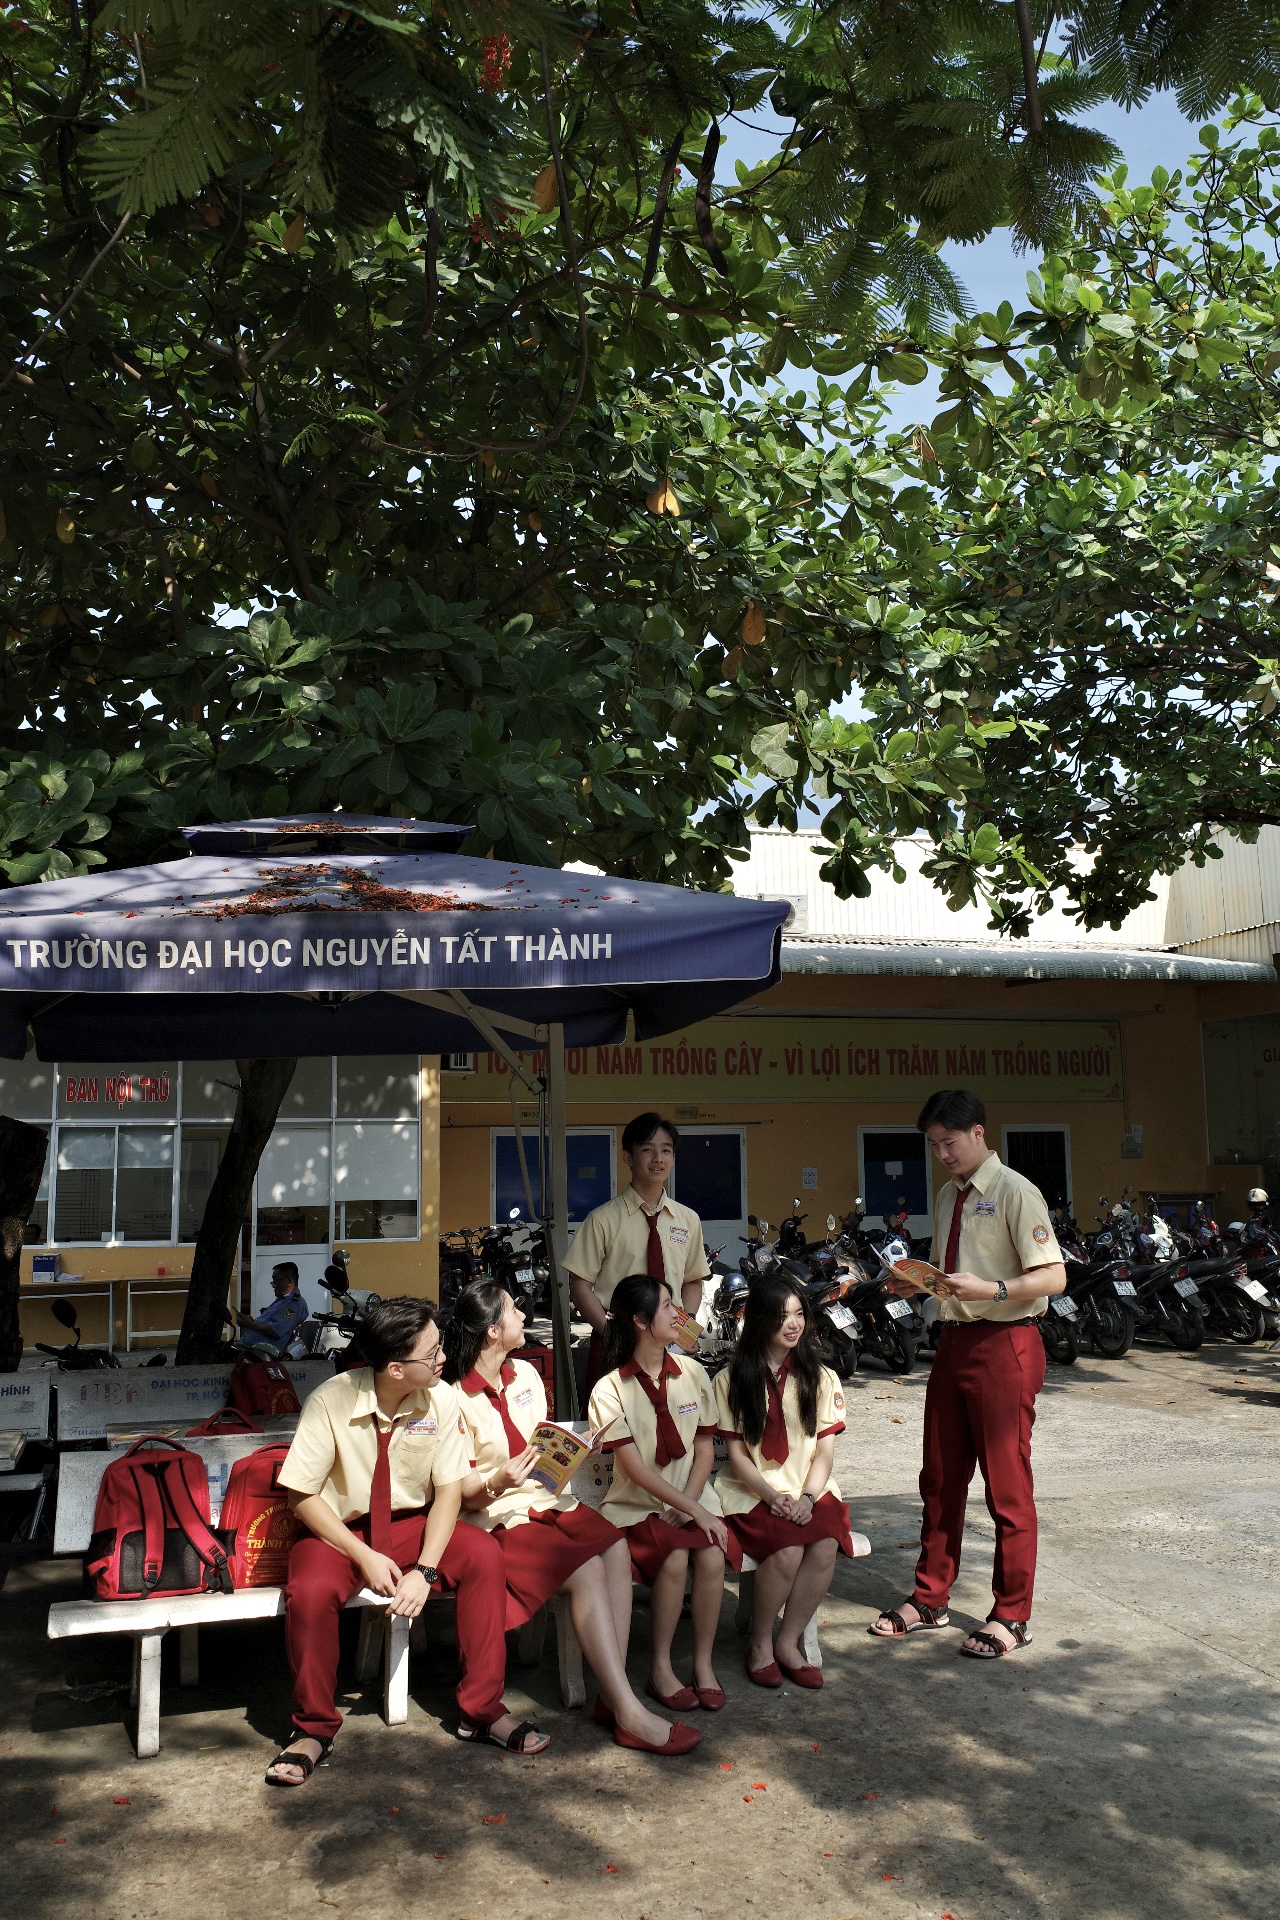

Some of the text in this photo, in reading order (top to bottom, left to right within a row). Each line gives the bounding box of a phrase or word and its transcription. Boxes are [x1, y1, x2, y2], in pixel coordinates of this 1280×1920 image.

[6, 928, 612, 975] TRƯỜNG ĐẠI HỌC NGUYỄN TẤT THÀNH
[650, 1037, 717, 1075] TRỒNG
[724, 1040, 763, 1075] CÂY
[784, 1041, 804, 1075] VÌ
[811, 1043, 841, 1081] LỢI
[847, 1041, 880, 1075] ÍCH
[886, 1043, 938, 1075] TRĂM
[945, 1043, 987, 1075] NĂM
[992, 1040, 1050, 1075] TRỒNG
[66, 1070, 169, 1110] BAN NỘI TRÚ
